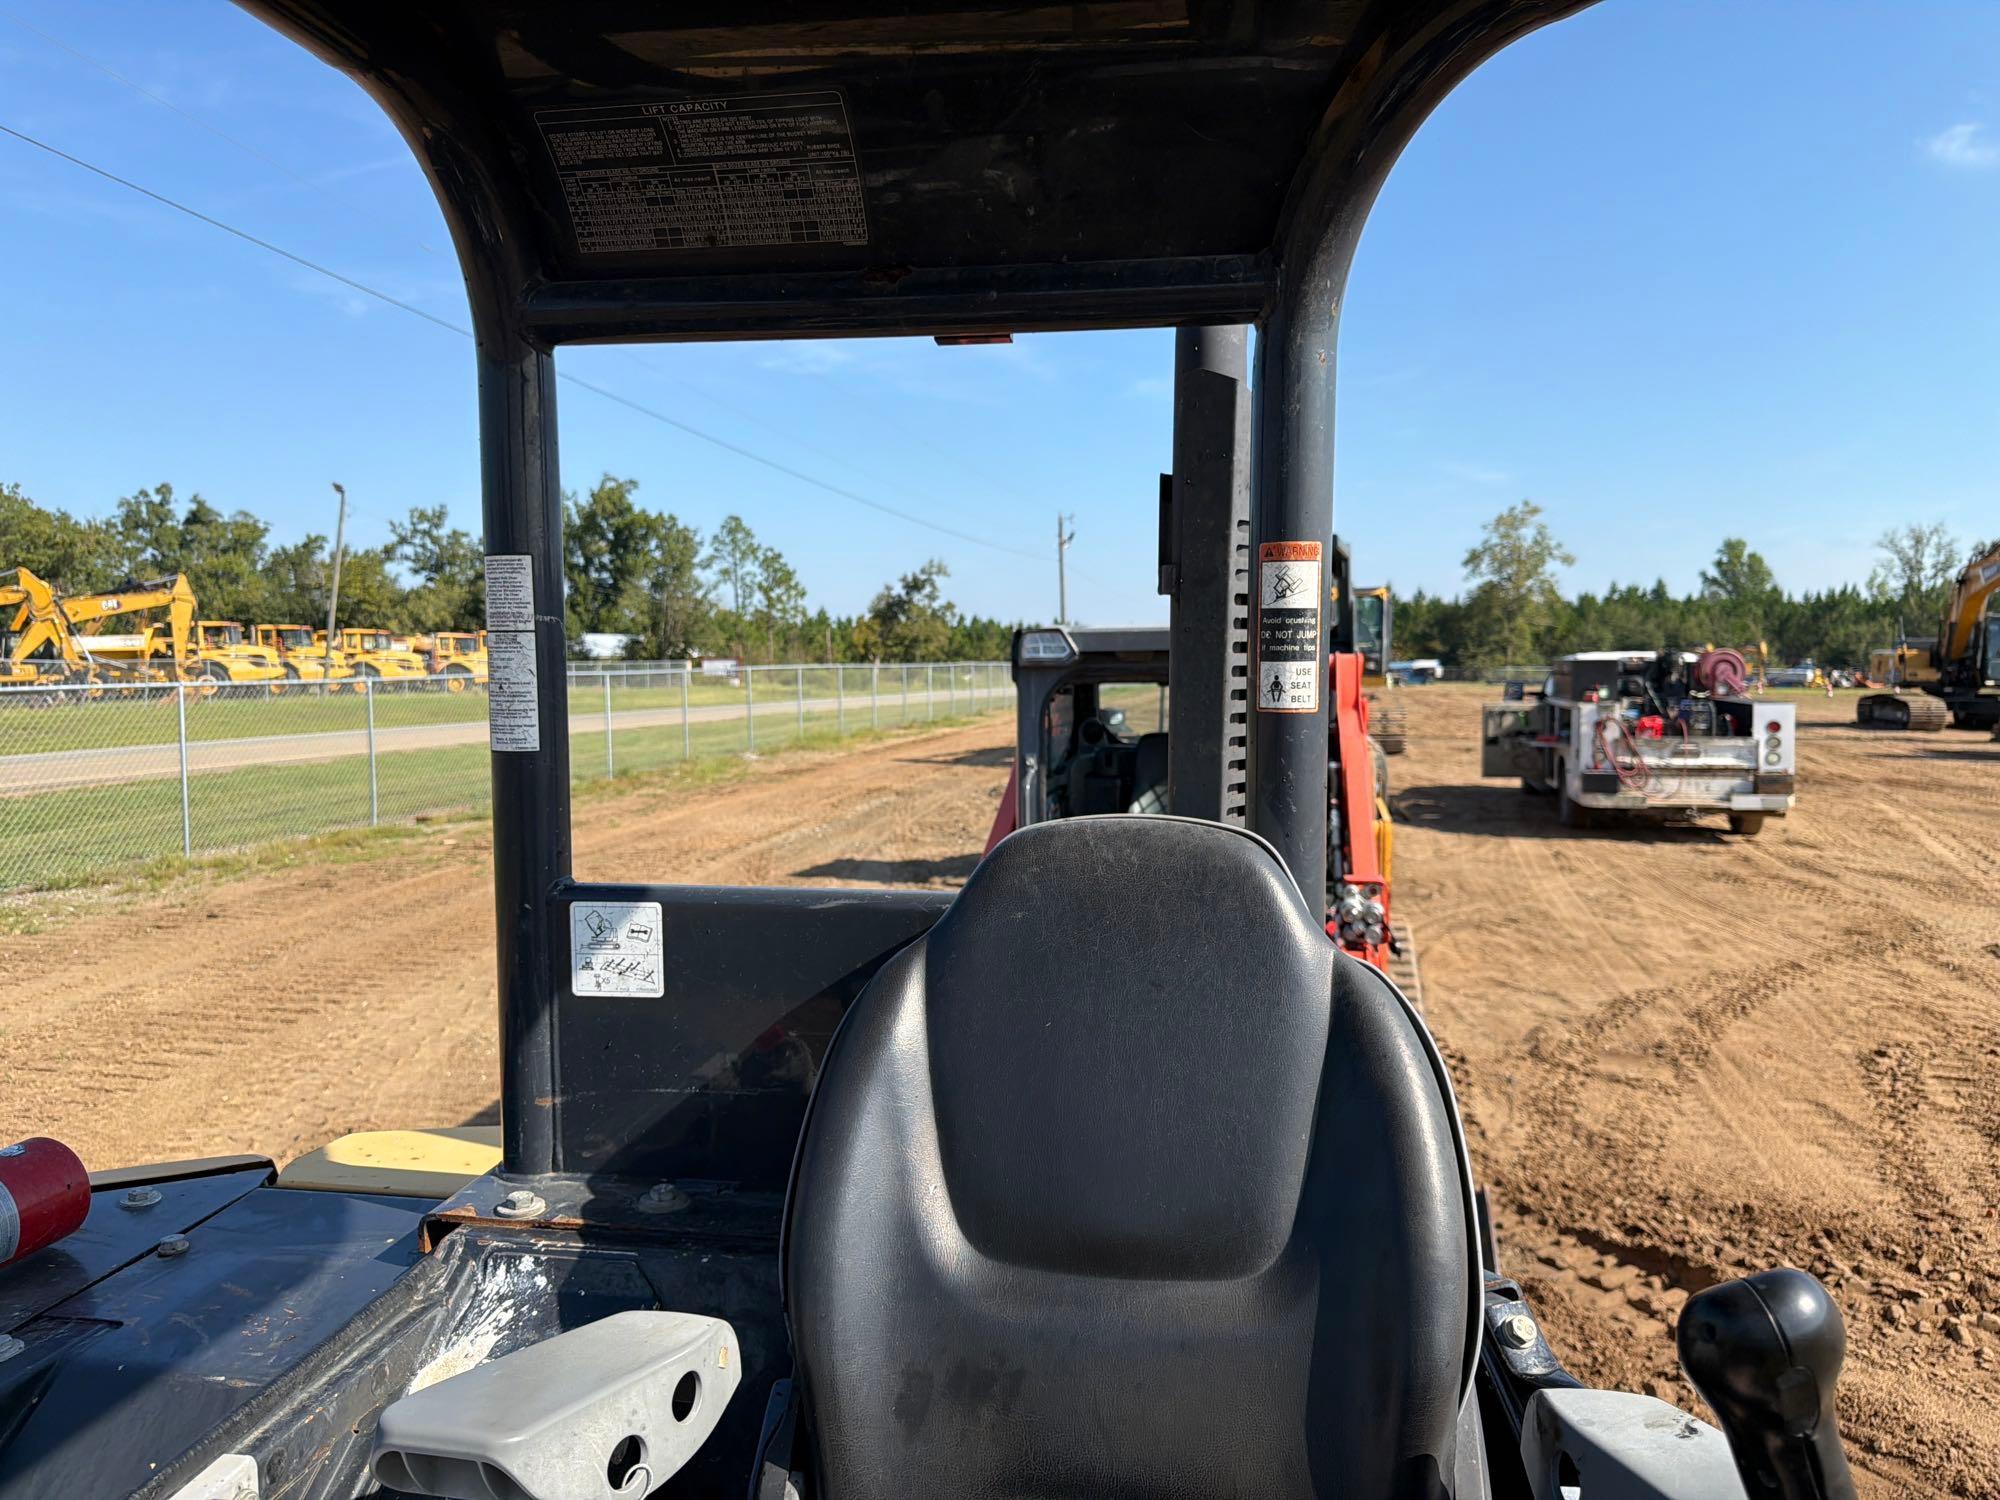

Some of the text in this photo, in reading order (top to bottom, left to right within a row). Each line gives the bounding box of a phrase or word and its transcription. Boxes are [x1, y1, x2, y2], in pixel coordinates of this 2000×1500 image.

[641, 100, 728, 115] LIFT CAPACITY
[1278, 544, 1319, 557] WARNING
[1262, 617, 1282, 625] Avoid
[1261, 630, 1318, 639] DO NOT JUMP
[1269, 643, 1300, 652] machine
[1303, 644, 1316, 653] tips
[1296, 667, 1312, 676] USE
[1290, 681, 1312, 690] SEAT
[1290, 695, 1312, 703] BELT
